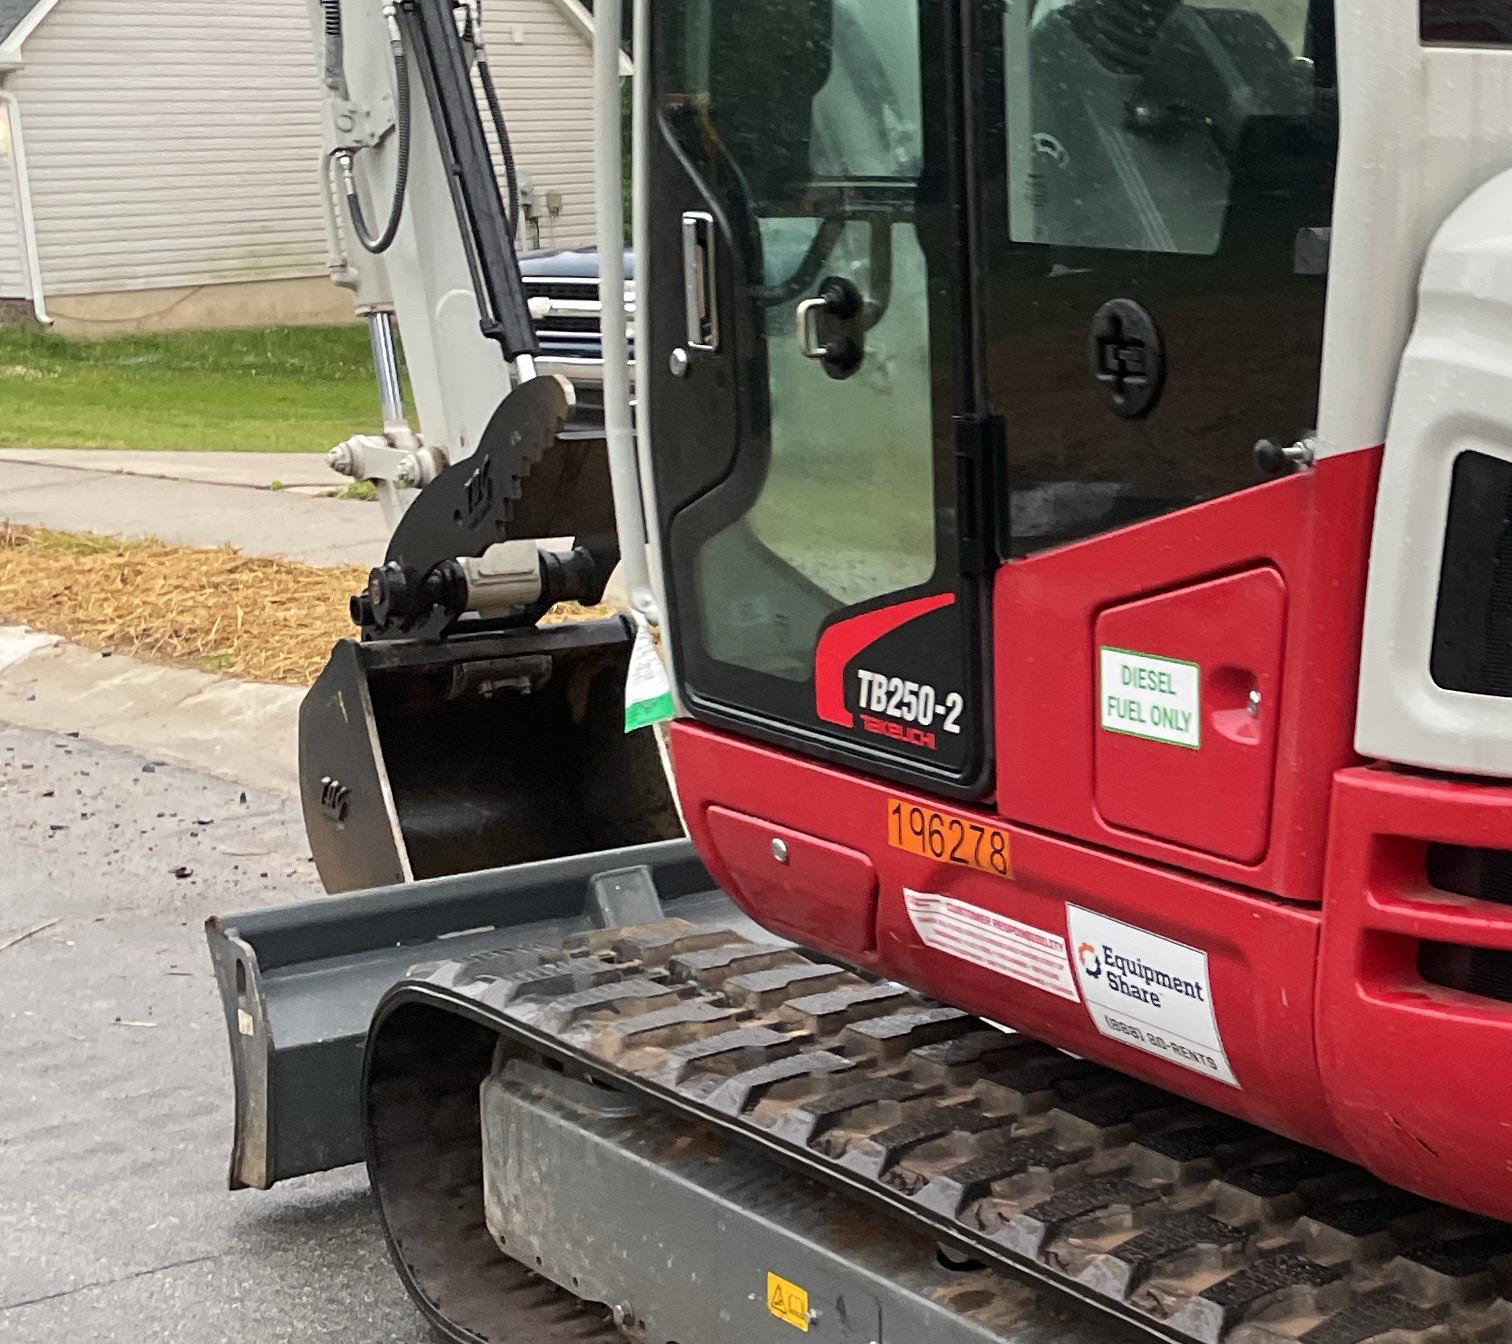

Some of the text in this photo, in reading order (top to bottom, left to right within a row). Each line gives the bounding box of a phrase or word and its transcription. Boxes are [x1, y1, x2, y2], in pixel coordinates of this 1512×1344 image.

[857, 669, 964, 735] TB250-2
[1120, 664, 1177, 696] DIESEL
[1107, 694, 1193, 735] FUEL ONLY
[891, 802, 1008, 876] 196278
[1101, 944, 1206, 1003] Equipment
[1106, 969, 1162, 1009] Share
